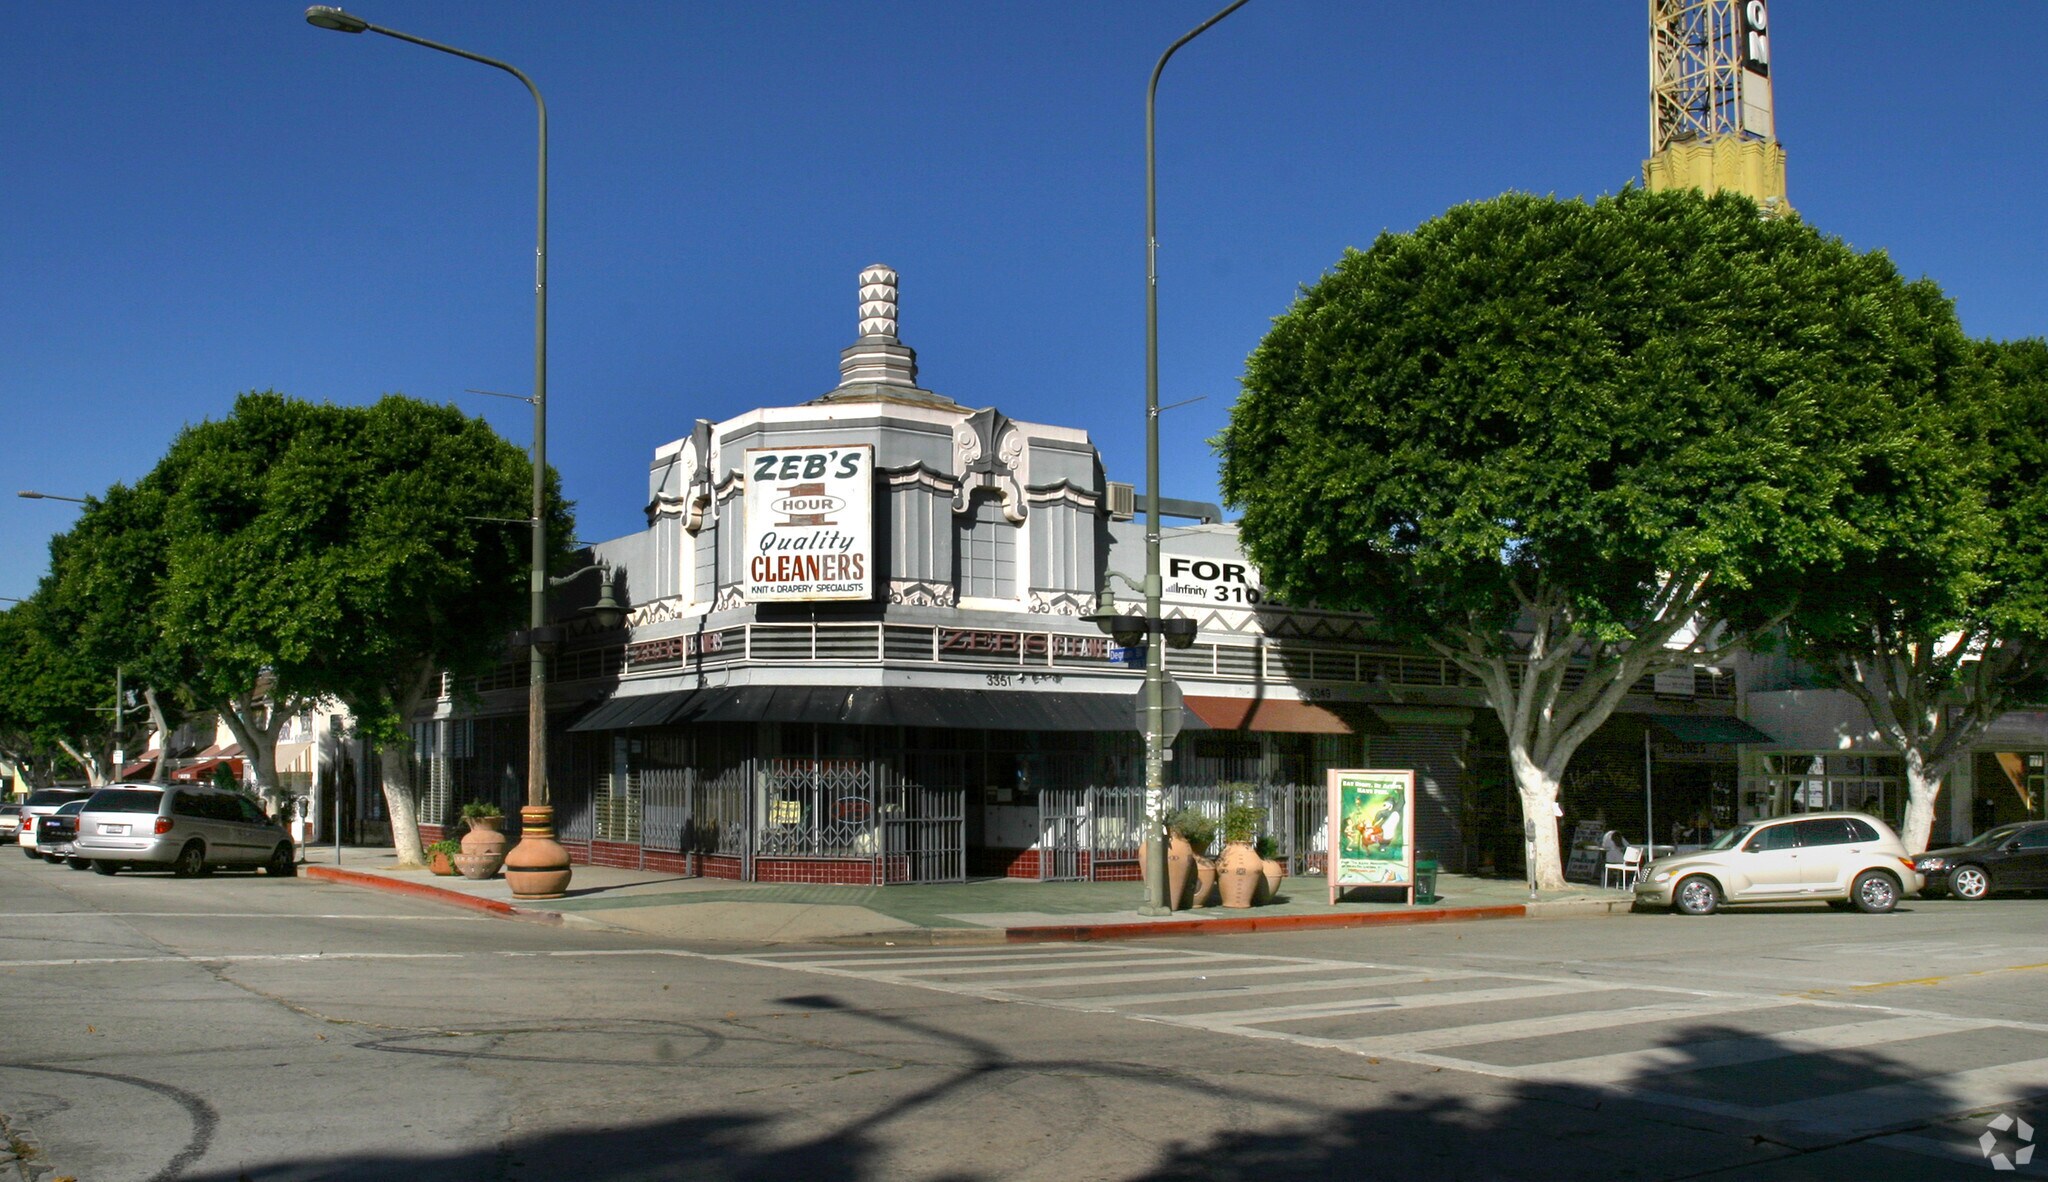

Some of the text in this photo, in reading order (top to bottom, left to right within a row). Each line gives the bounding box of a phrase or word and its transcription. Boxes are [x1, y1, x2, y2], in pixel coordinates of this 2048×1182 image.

[753, 450, 862, 482] ZEB'S
[782, 499, 834, 510] HOUR
[759, 531, 855, 556] Quality
[751, 553, 864, 582] CLEANERS
[1169, 558, 1247, 583] FOR
[751, 585, 768, 593] KNIT
[776, 584, 813, 593] DRAPERY
[816, 583, 864, 592] SPECIALISTS
[1175, 582, 1208, 599] Infinity
[986, 673, 1012, 687] 3351
